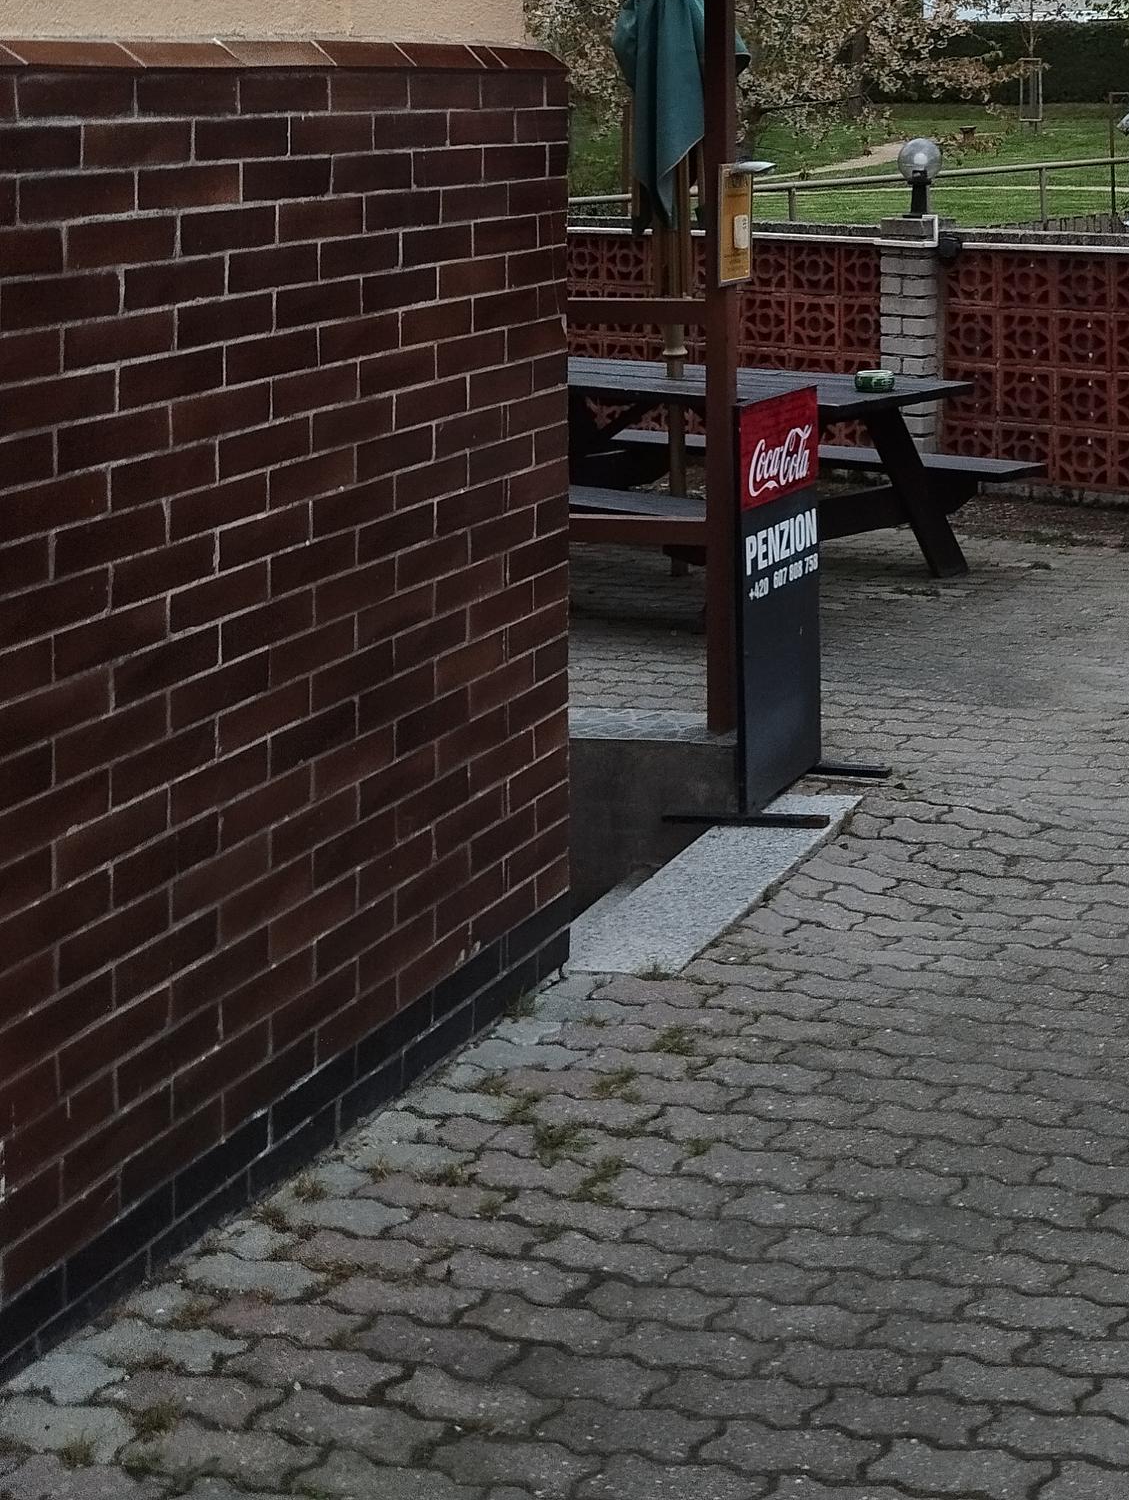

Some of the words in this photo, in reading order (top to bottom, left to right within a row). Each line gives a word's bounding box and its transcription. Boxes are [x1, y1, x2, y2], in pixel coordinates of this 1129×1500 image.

[749, 424, 813, 497] Coca-Cola
[745, 508, 817, 576] PENZION
[749, 577, 769, 600] +420
